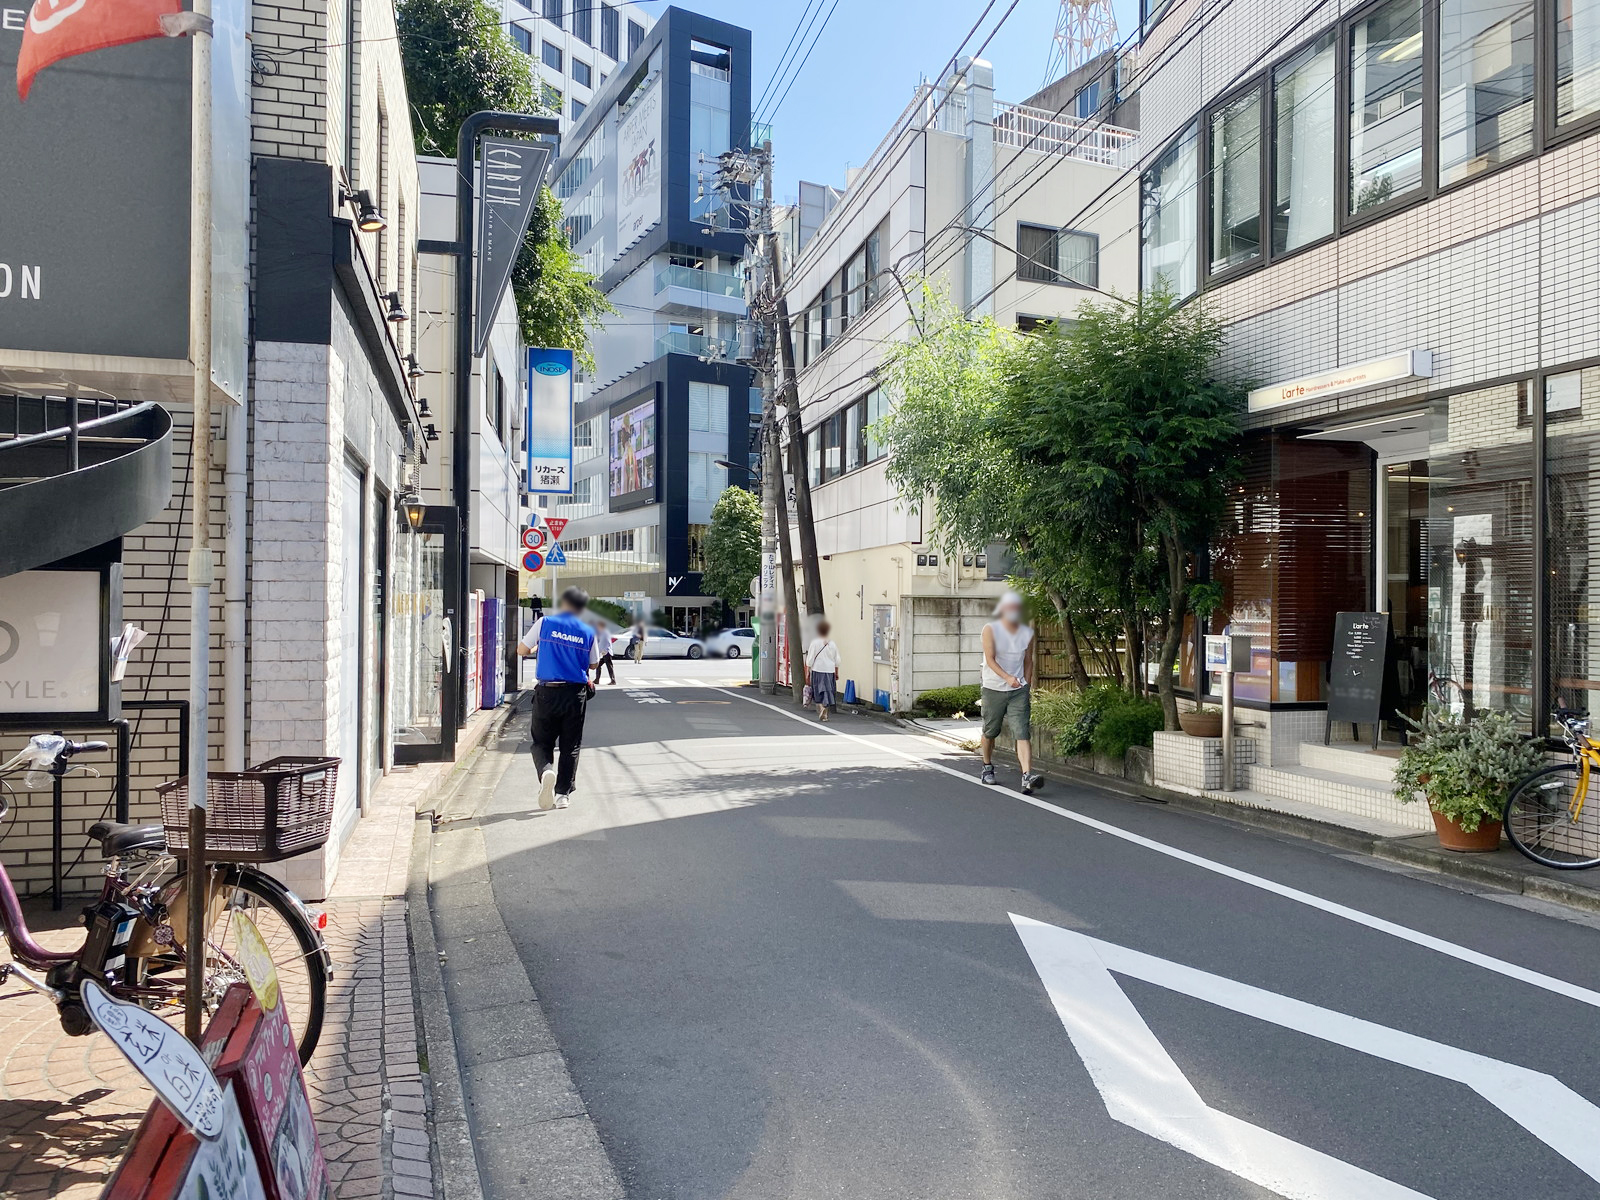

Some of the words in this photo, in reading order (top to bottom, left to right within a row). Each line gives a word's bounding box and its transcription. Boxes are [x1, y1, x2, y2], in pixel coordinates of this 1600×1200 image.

[486, 148, 522, 206] EARTH
[1282, 385, 1305, 400] L'arte
[535, 465, 566, 474] リカース
[527, 534, 541, 544] 30
[551, 630, 584, 645] SAGAWA
[0, 680, 57, 699] YLE
